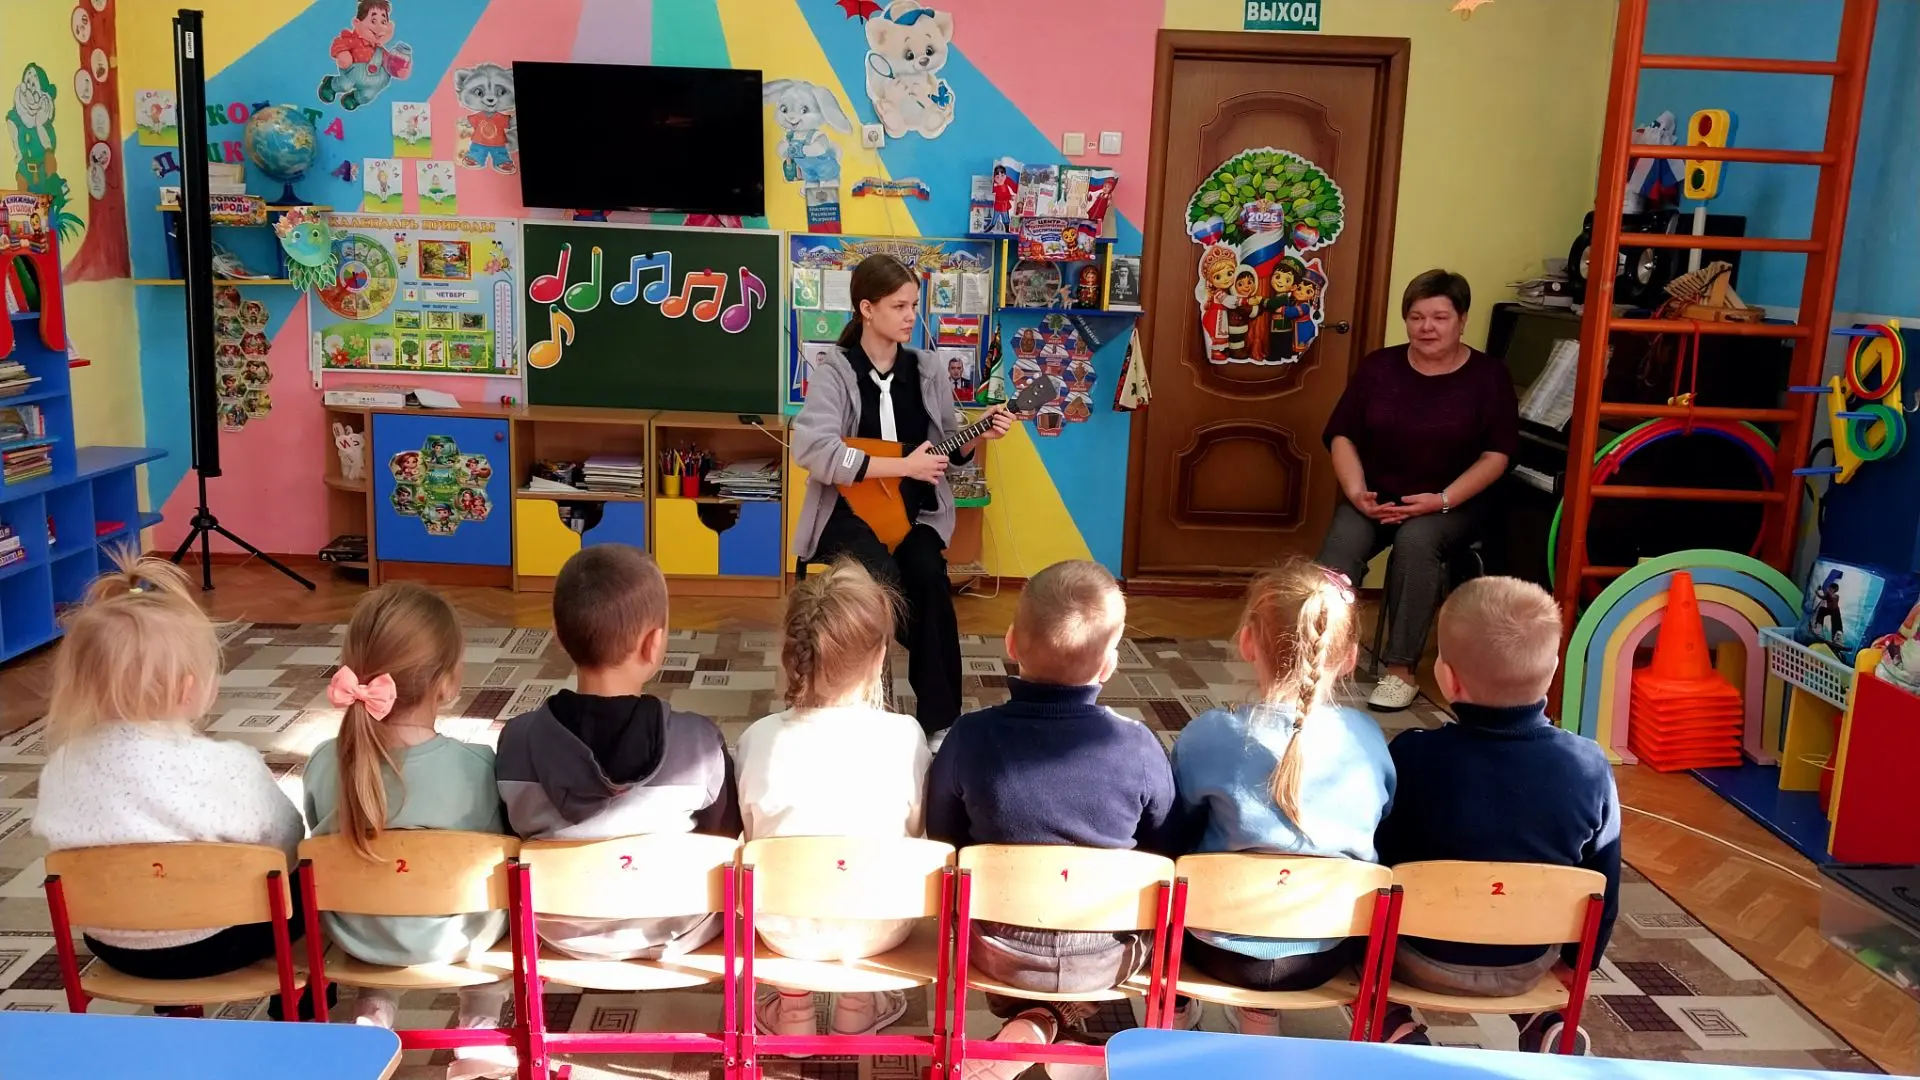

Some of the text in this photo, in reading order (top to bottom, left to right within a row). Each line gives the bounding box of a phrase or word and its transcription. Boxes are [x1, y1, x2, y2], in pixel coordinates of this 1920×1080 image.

[1247, 1, 1317, 26] ВЫХОД
[210, 195, 244, 203] ГОЛОК
[210, 202, 250, 213] РИРОДЫ
[1247, 211, 1278, 223] 2026
[328, 216, 496, 233] КАЛЕНДАРЬ ПРИРОДЫ
[407, 290, 466, 299] 4 ЧЕТВЕРГ
[396, 859, 409, 873] 2
[1490, 881, 1506, 896] 2
